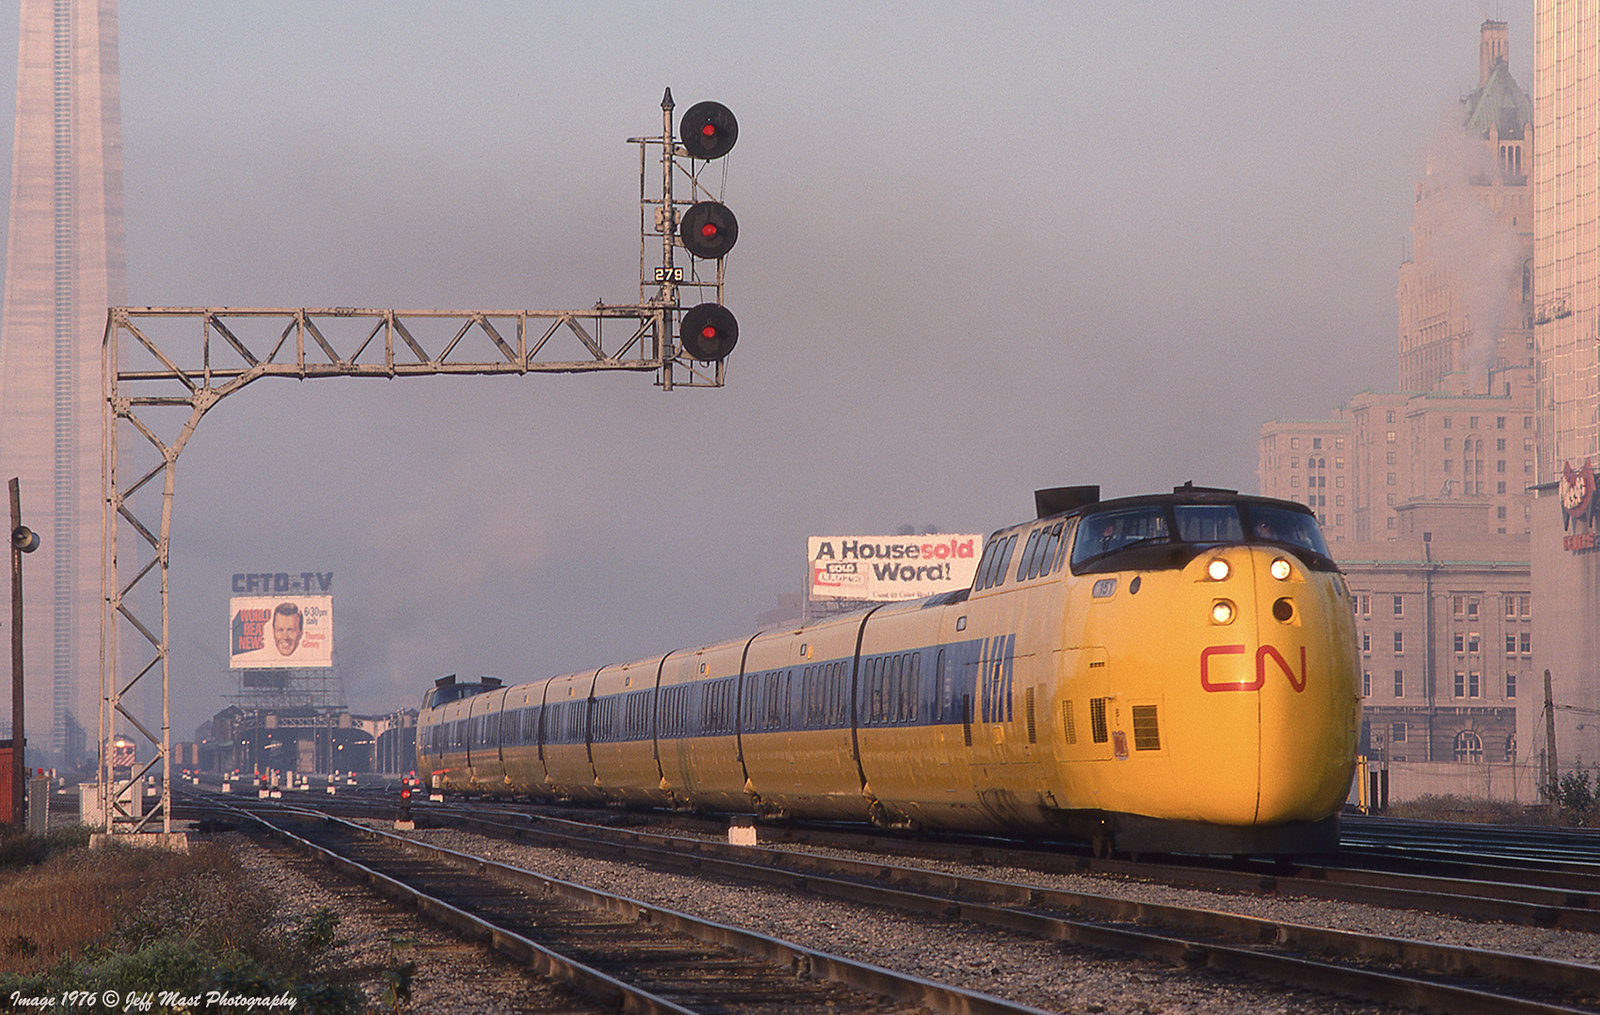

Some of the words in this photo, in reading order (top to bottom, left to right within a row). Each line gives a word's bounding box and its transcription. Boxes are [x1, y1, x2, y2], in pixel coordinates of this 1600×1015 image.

[655, 268, 683, 281] 279
[816, 541, 835, 560] A
[829, 563, 855, 574] SOLD
[872, 562, 952, 582] Word!
[232, 572, 333, 592] CFTO-TV
[240, 609, 271, 622] WORLD
[243, 622, 266, 636] BEAT
[239, 636, 265, 650] NEWS
[1200, 644, 1306, 693] CN
